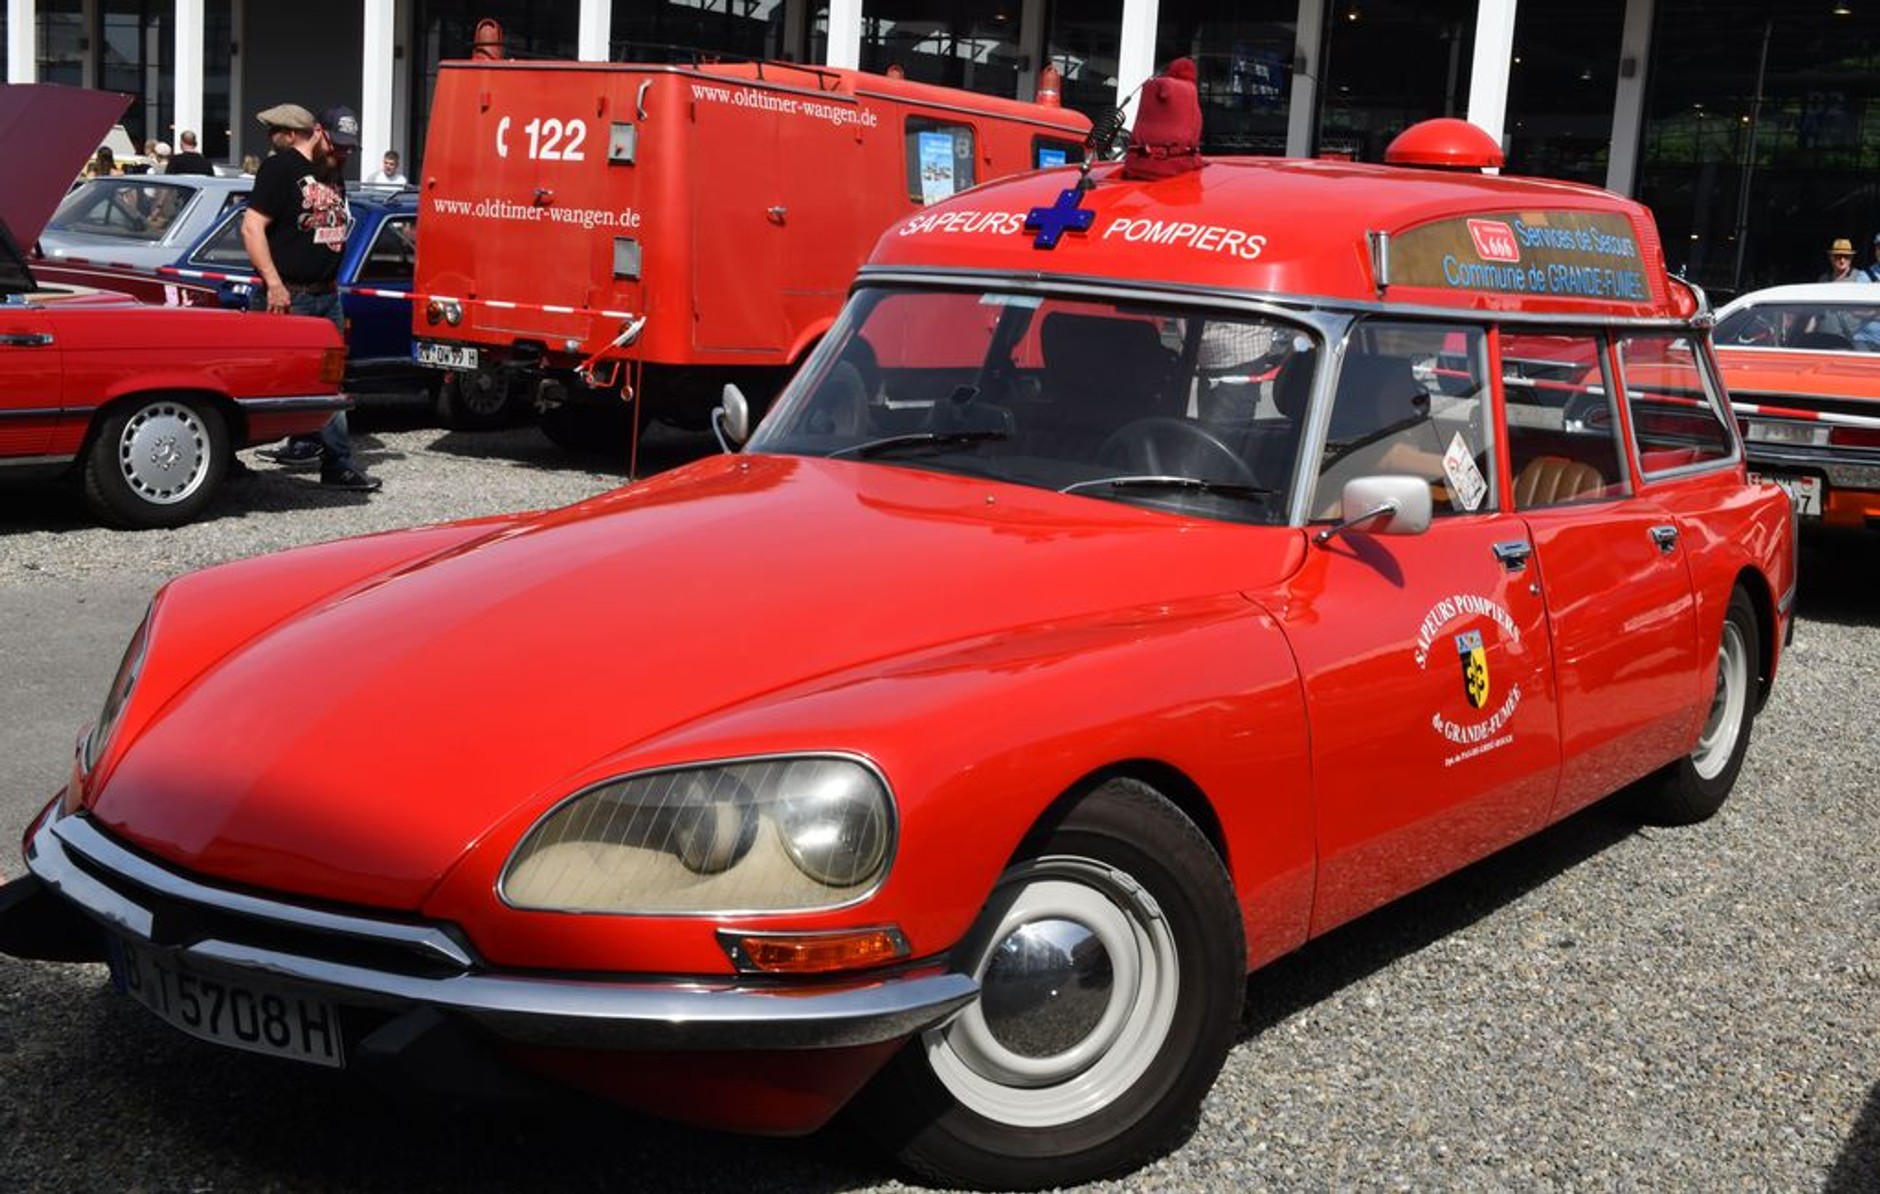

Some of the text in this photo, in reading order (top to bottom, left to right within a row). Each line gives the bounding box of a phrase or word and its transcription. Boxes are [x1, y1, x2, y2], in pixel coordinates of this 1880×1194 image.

[691, 84, 877, 127] www.oldtimer-wangen.de
[525, 117, 587, 161] 122
[434, 198, 640, 229] www.oldtimer-wangen.de
[900, 211, 1267, 260] SAPEURS POMPIERS
[1513, 219, 1576, 250] Services
[1574, 229, 1593, 251] de
[1442, 255, 1525, 290] Commune
[1528, 263, 1545, 292] de
[1415, 594, 1522, 670] SAPEURS POMPIERS
[1432, 712, 1444, 734] de
